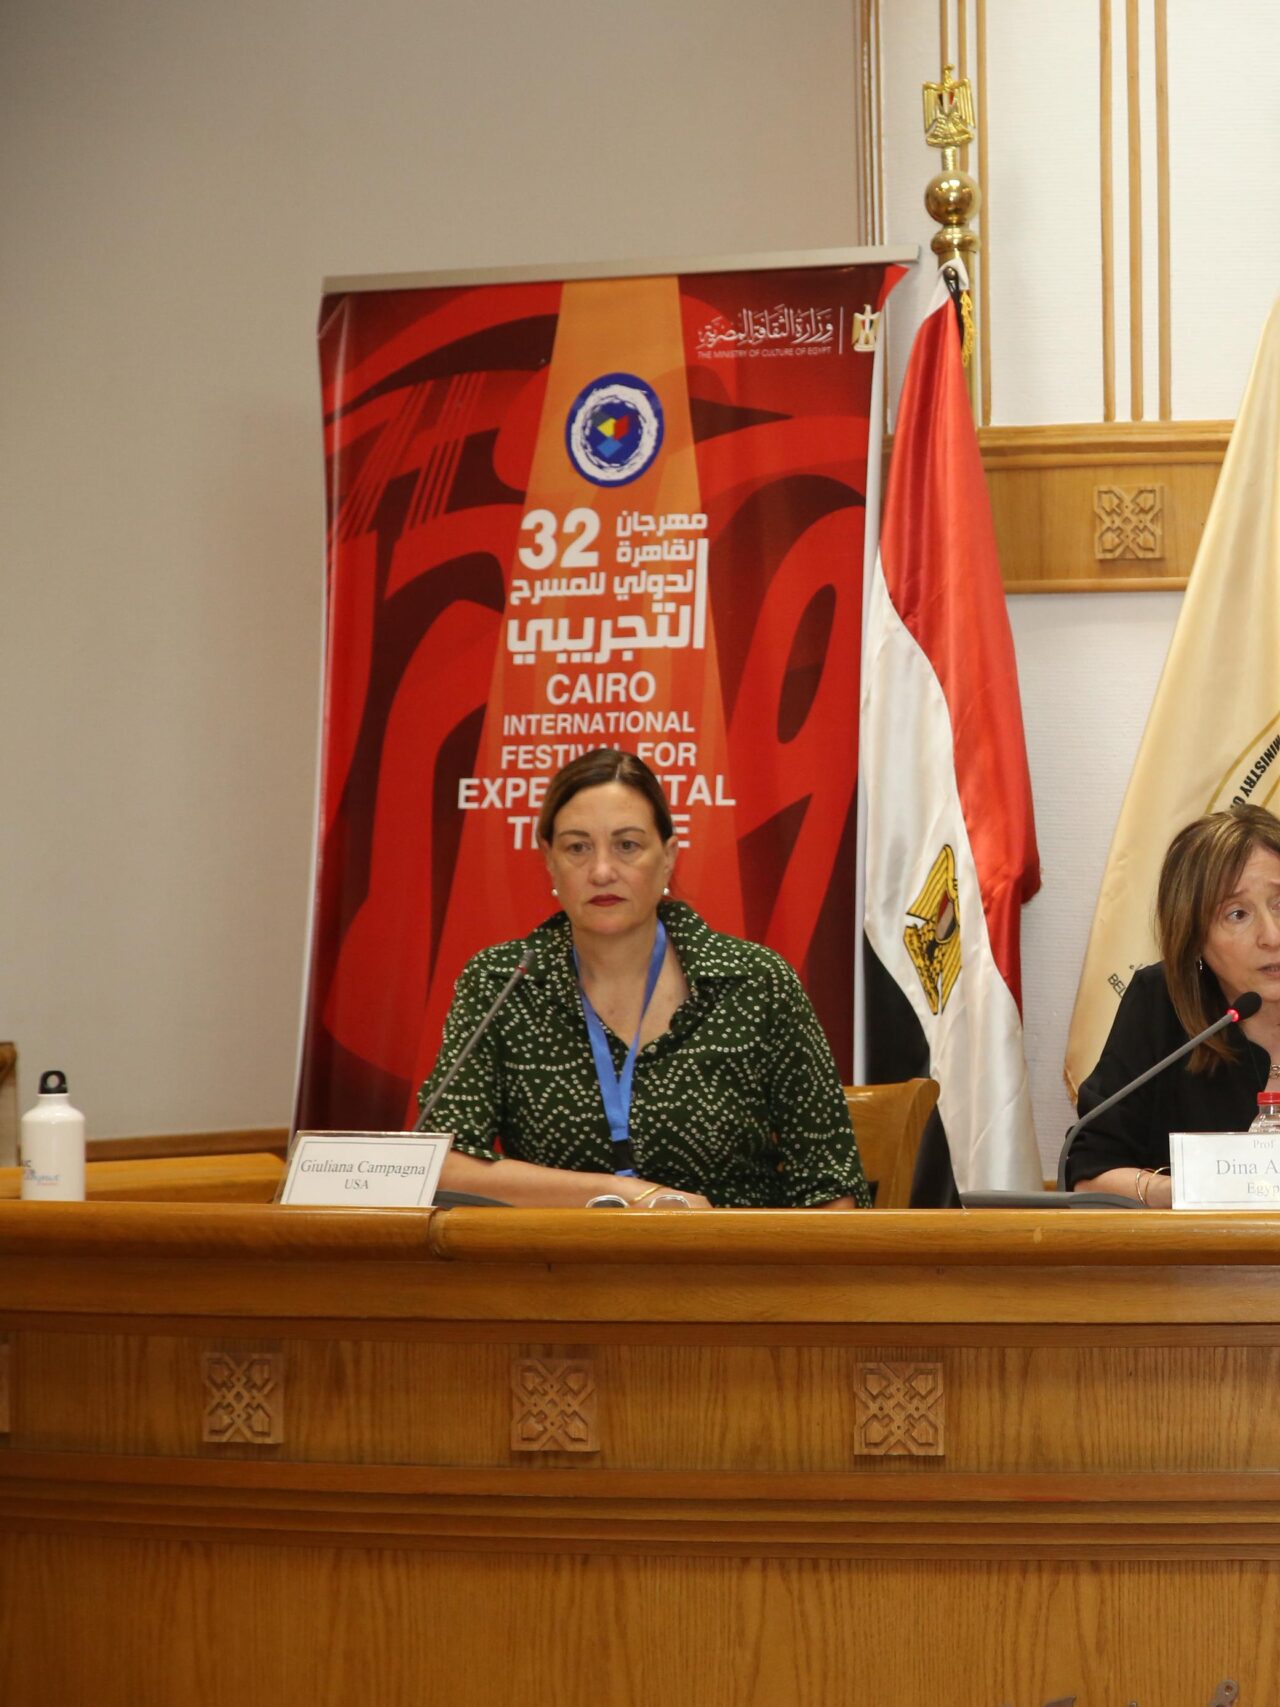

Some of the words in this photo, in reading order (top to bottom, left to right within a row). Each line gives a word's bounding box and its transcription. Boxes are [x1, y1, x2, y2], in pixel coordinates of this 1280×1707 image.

[714, 349, 746, 358] MINISTRY
[749, 349, 760, 357] OF
[761, 347, 794, 357] CULTURE
[795, 347, 806, 356] OF
[807, 346, 832, 355] EGYPT
[616, 510, 708, 538] مهرجان
[518, 507, 600, 570] 32
[510, 571, 607, 606] للمسرح
[506, 602, 708, 665] التجريبي
[546, 671, 656, 706] CAIRO
[503, 711, 695, 736] INTERNATIONAL
[501, 743, 620, 770] FESTI
[637, 742, 697, 767] FOR
[1230, 795, 1247, 809] O
[300, 1159, 354, 1173] Giuliana
[357, 1160, 426, 1177] Campagna
[1216, 1158, 1258, 1175] Dina
[344, 1178, 370, 1190] USA
